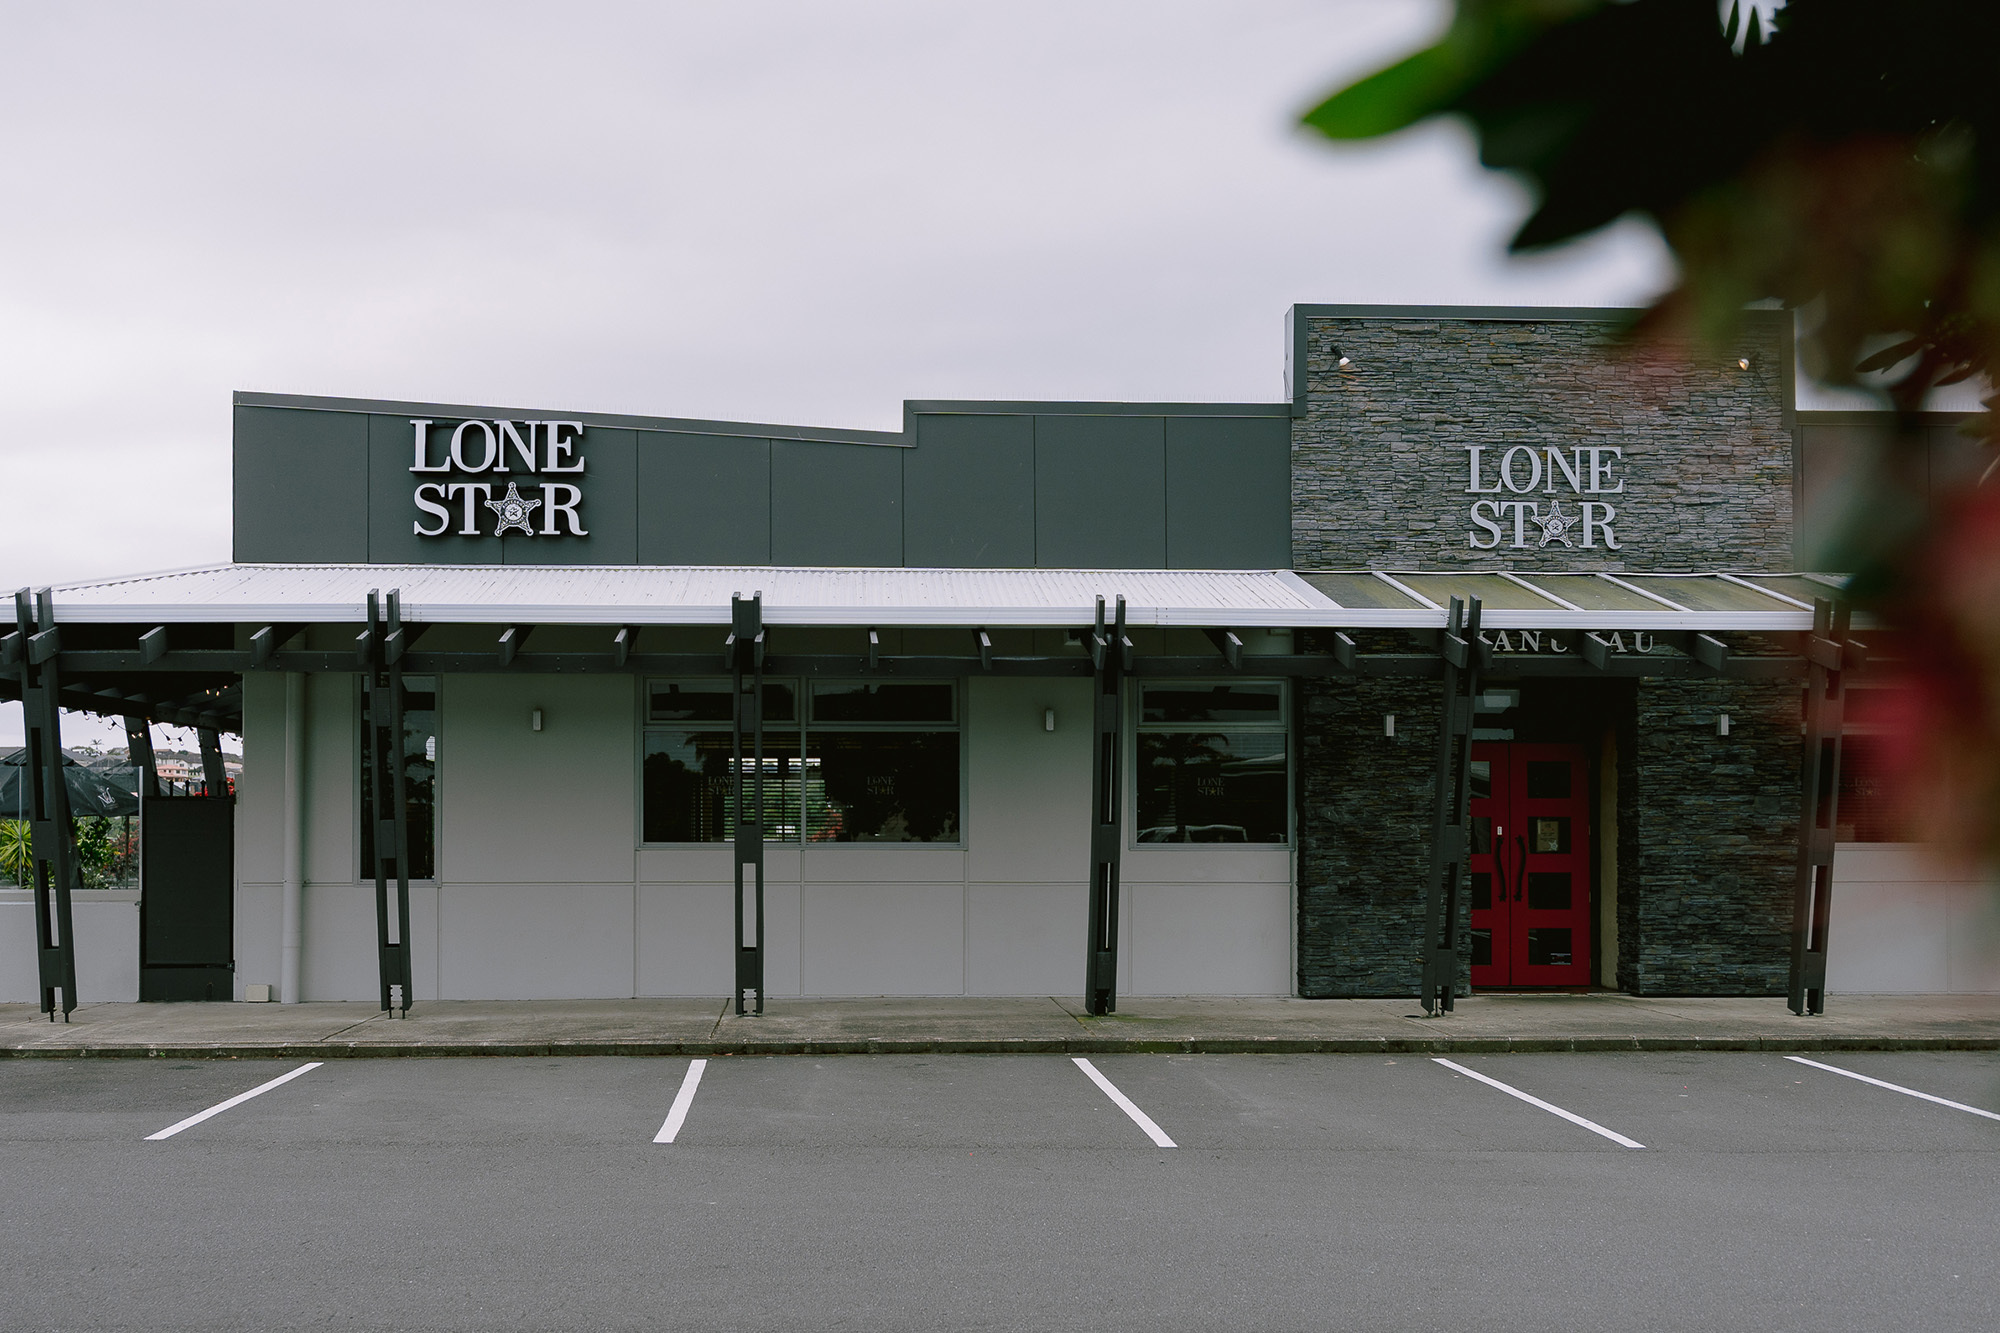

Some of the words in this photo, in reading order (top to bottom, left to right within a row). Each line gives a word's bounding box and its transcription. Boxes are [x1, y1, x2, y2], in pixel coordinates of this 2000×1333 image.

[408, 419, 585, 473] LONE
[1465, 445, 1623, 494] LONE
[707, 775, 734, 785] LONE
[866, 775, 895, 785] LONE
[1197, 777, 1225, 786] LONE
